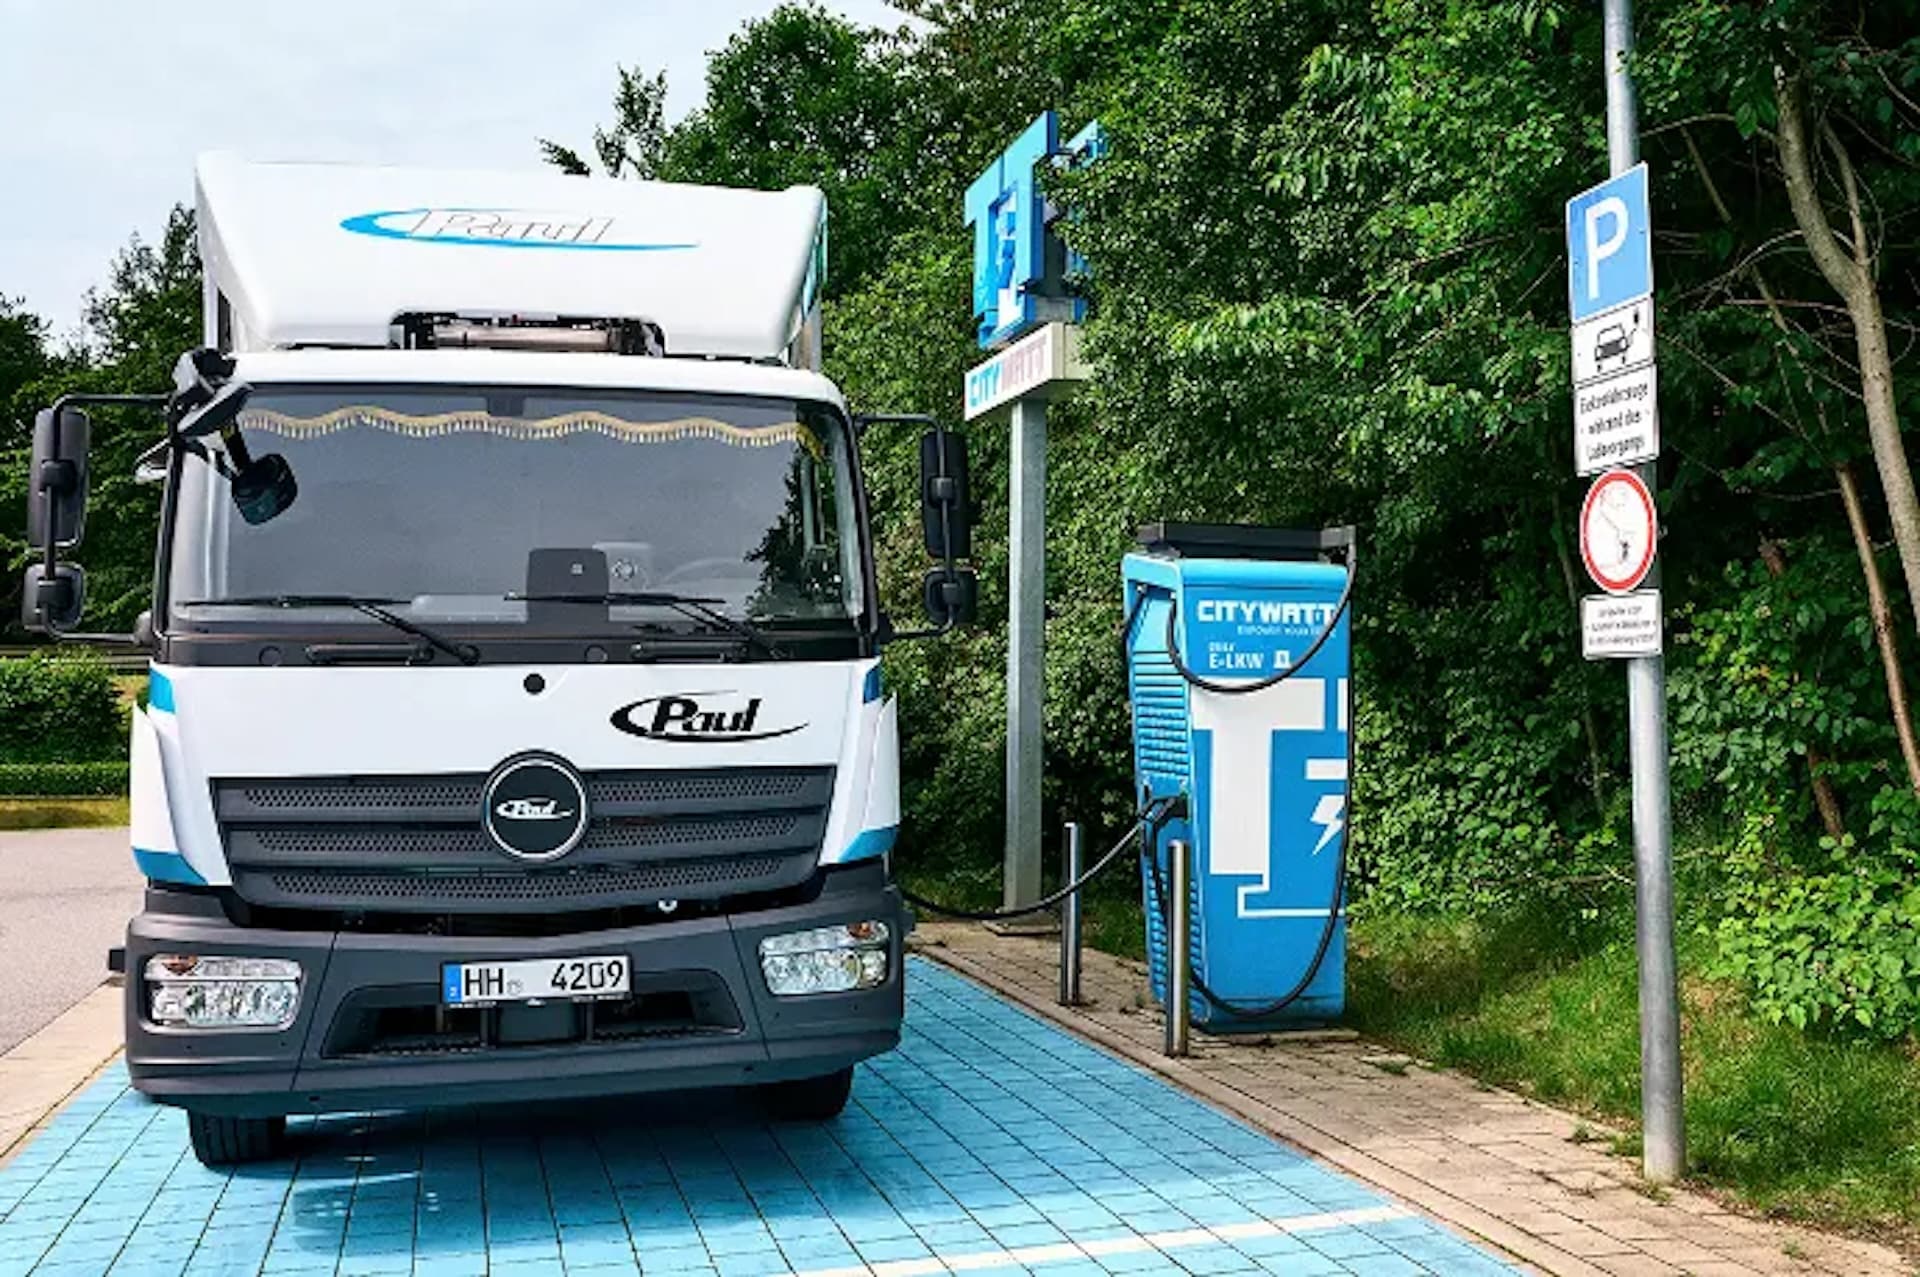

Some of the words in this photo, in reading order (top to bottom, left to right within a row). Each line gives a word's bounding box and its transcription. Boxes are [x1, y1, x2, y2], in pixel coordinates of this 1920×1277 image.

[1585, 196, 1628, 300] P
[969, 332, 1048, 408] CITYWATT
[1197, 600, 1337, 625] CITYWATT
[1209, 653, 1265, 669] E-LKW
[651, 698, 762, 733] Paul
[464, 968, 505, 997] HH
[551, 959, 624, 992] 4209
